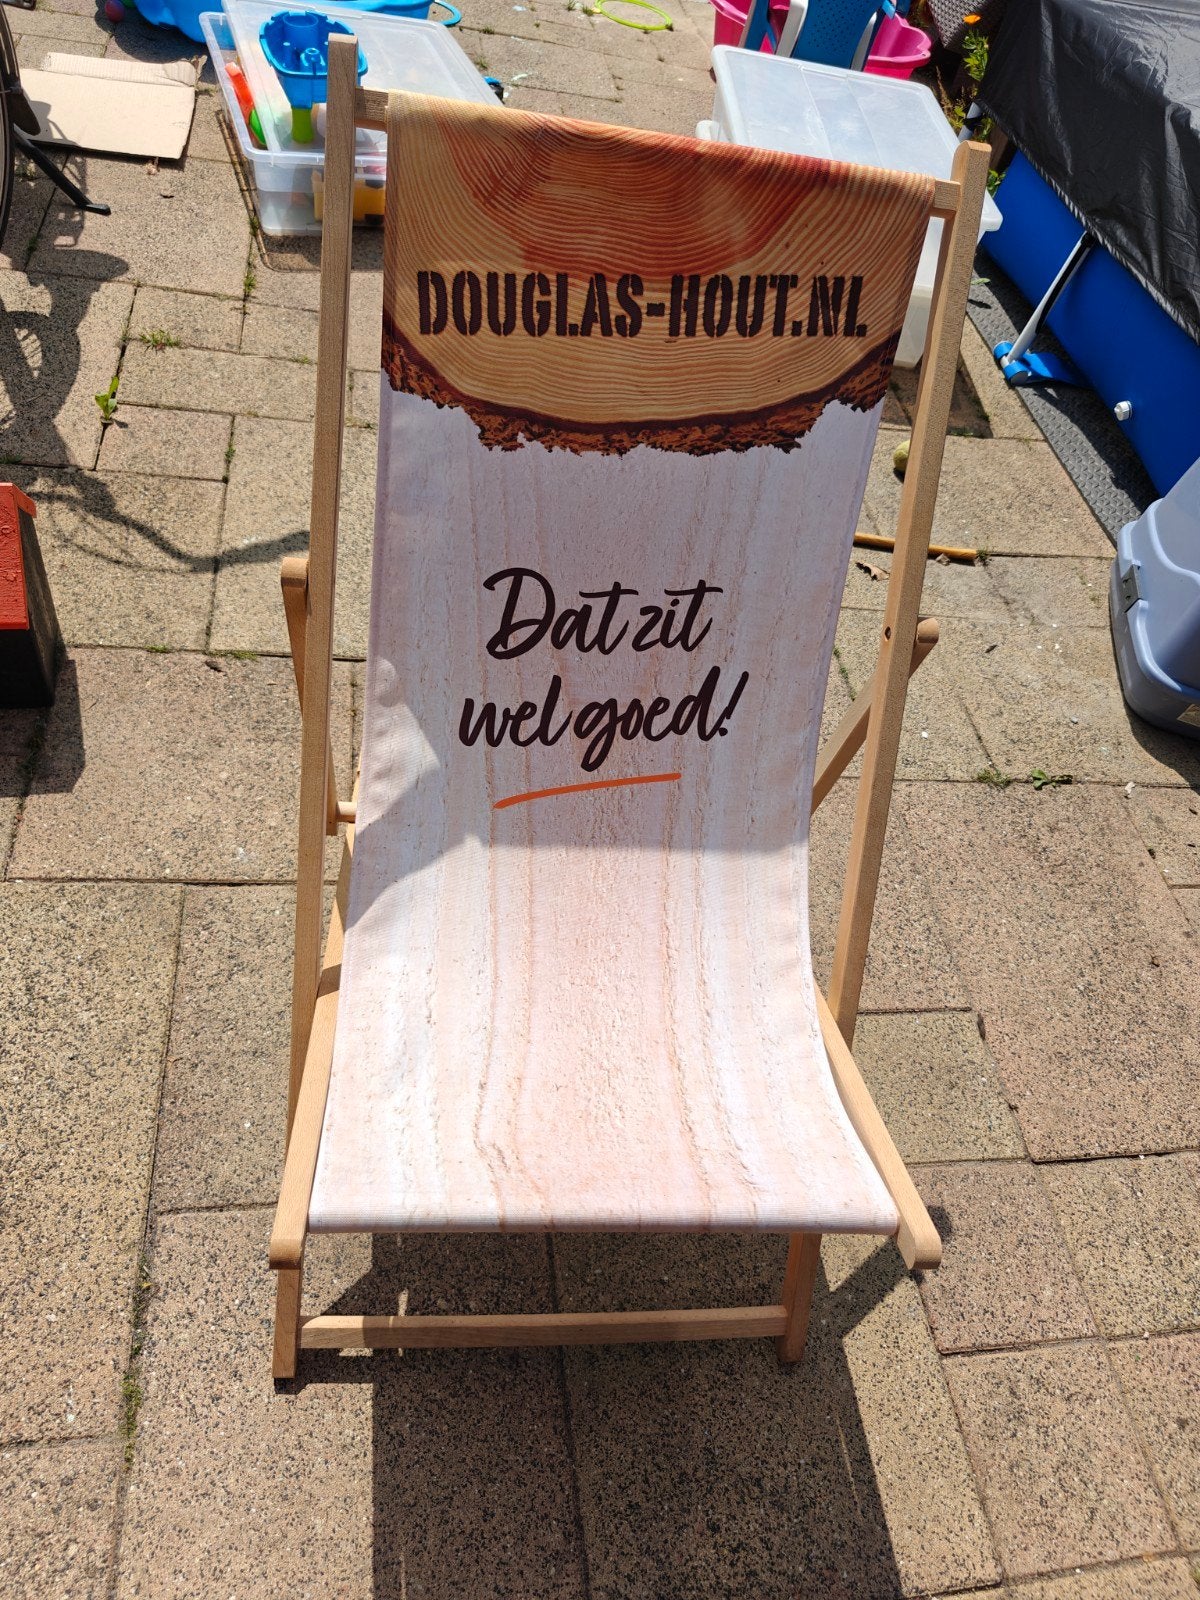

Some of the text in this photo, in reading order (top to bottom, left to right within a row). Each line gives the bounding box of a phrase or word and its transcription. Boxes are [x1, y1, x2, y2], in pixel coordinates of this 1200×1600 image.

[417, 271, 867, 337] DOUGLAS-HOUT.NL
[483, 567, 724, 660] Dat zit
[458, 665, 749, 772] wel goed!
